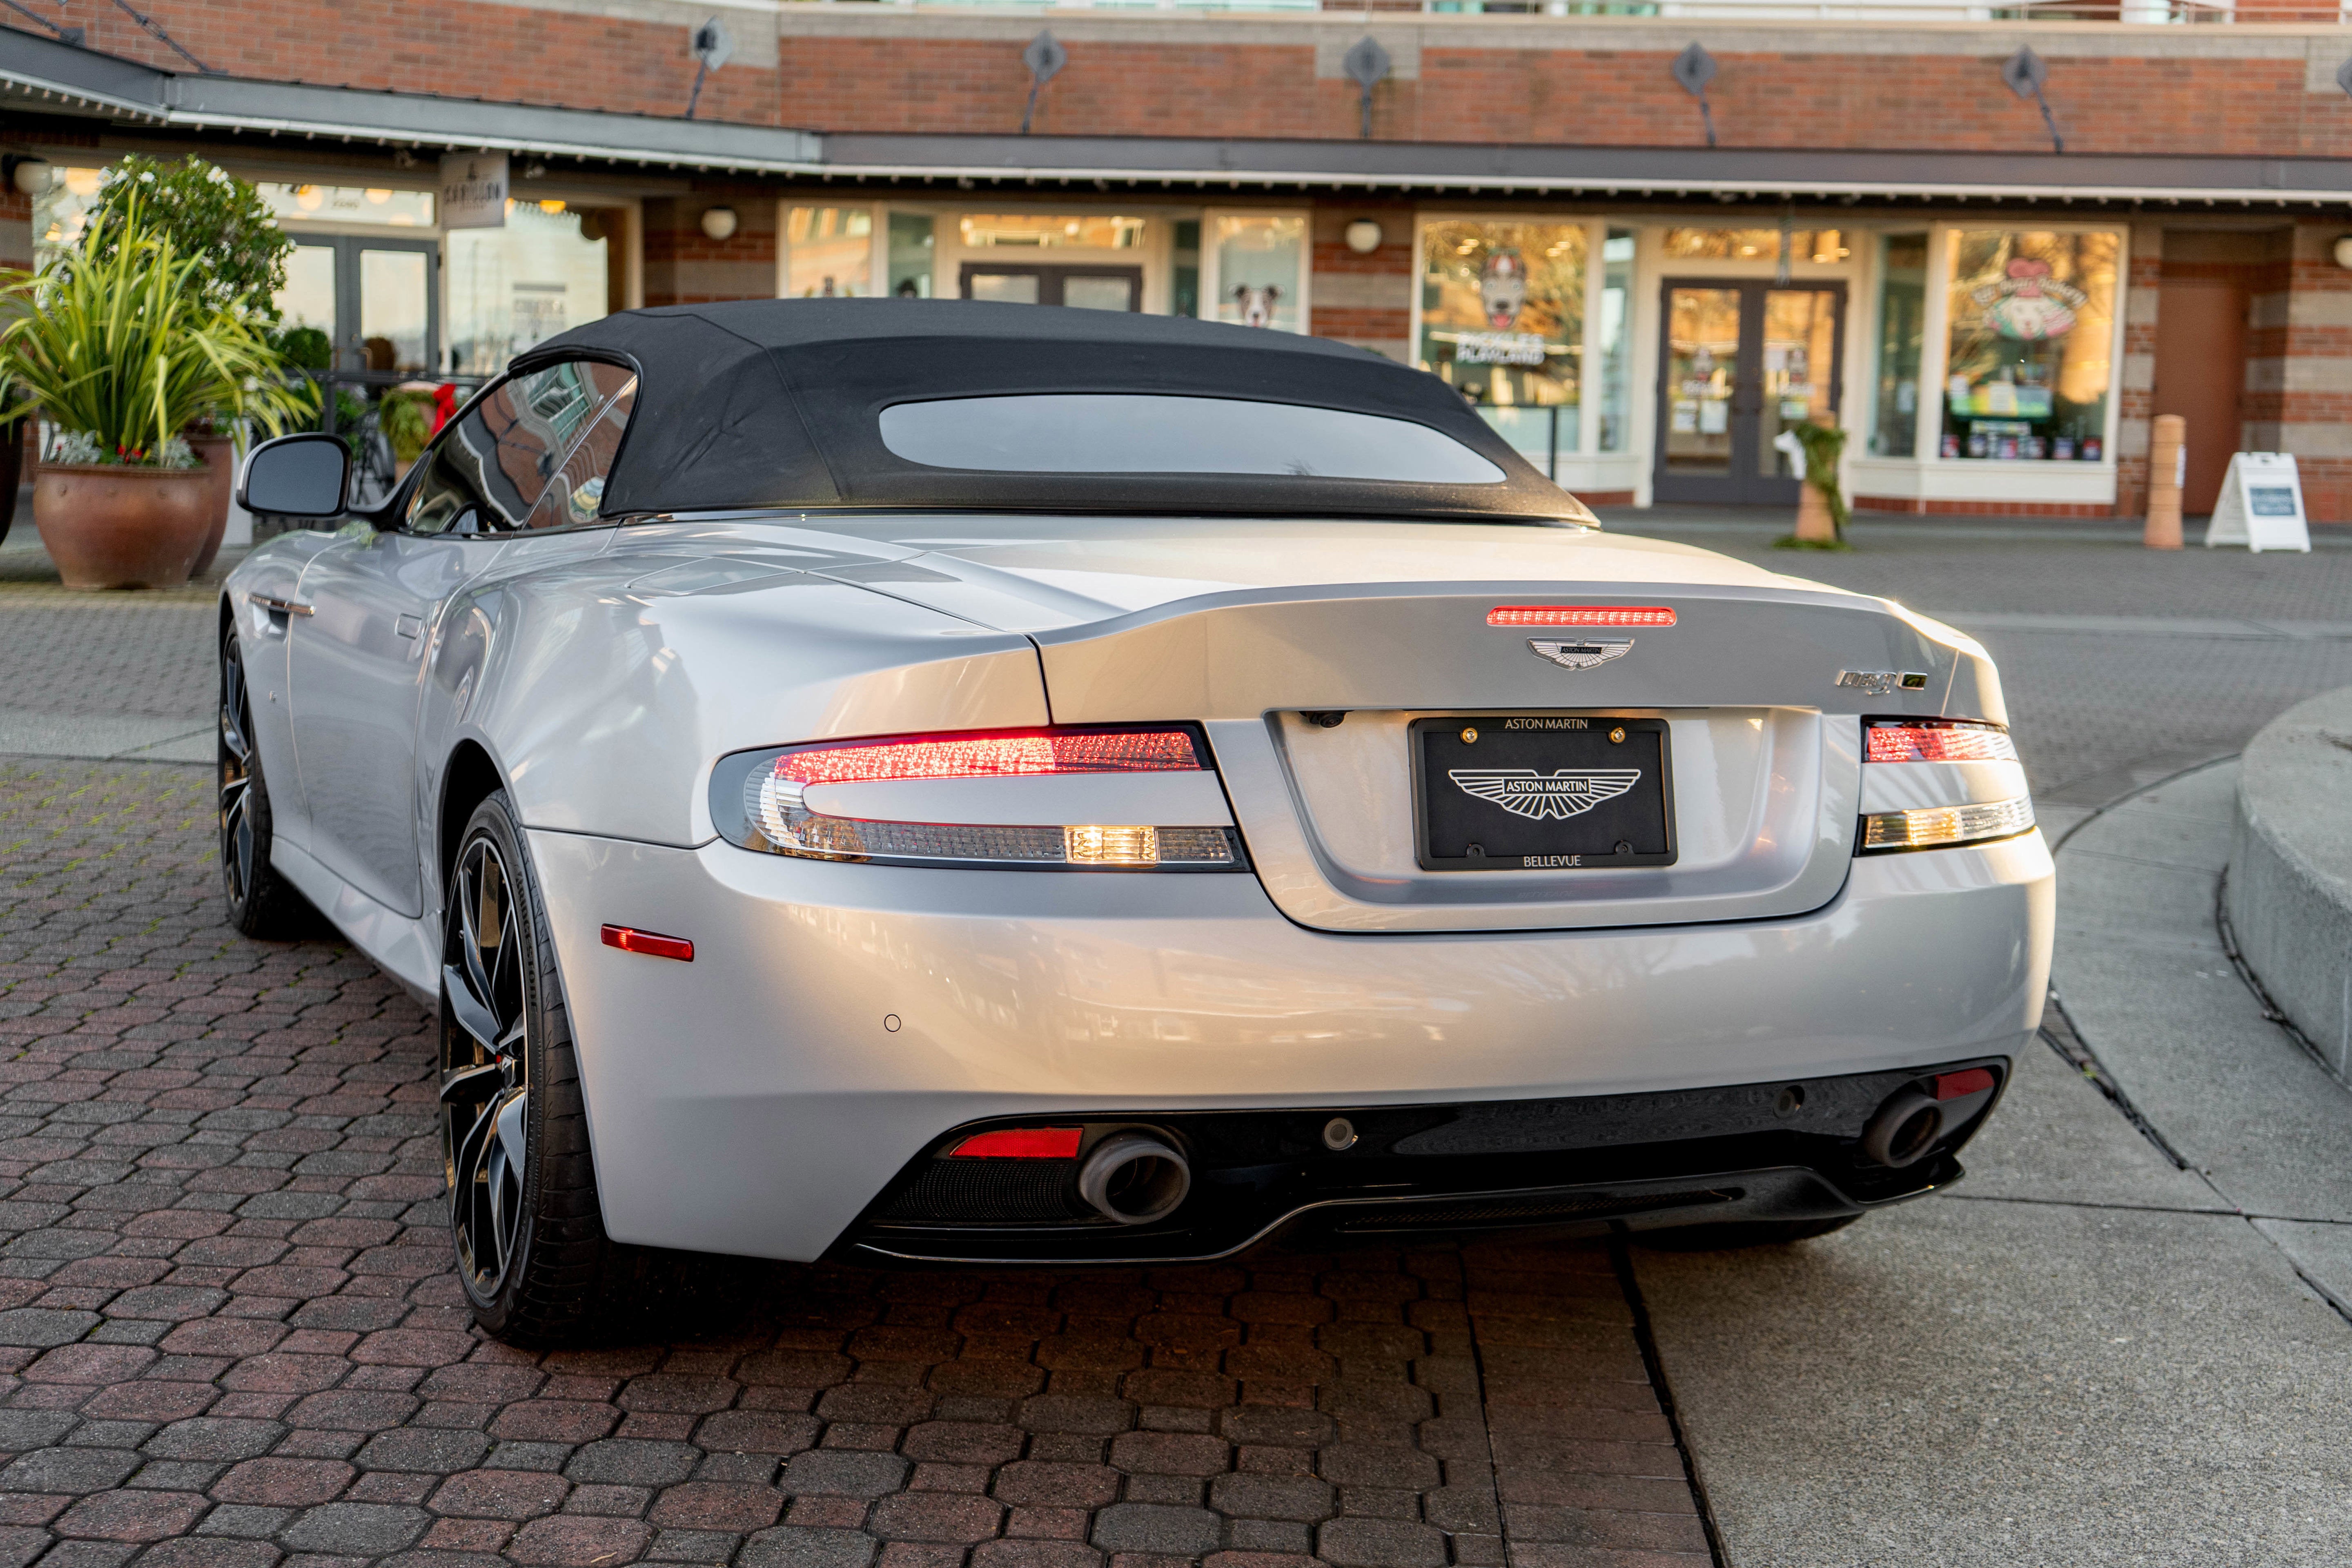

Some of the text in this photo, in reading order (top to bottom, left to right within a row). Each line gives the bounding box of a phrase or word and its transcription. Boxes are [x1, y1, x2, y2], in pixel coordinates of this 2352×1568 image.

[1505, 718, 1588, 729] ASTON MARTIN
[1506, 781, 1588, 792] ASTON MARTIN
[1523, 855, 1581, 867] BELLEVUE
[514, 870, 538, 1016] BRIDGESTONE
